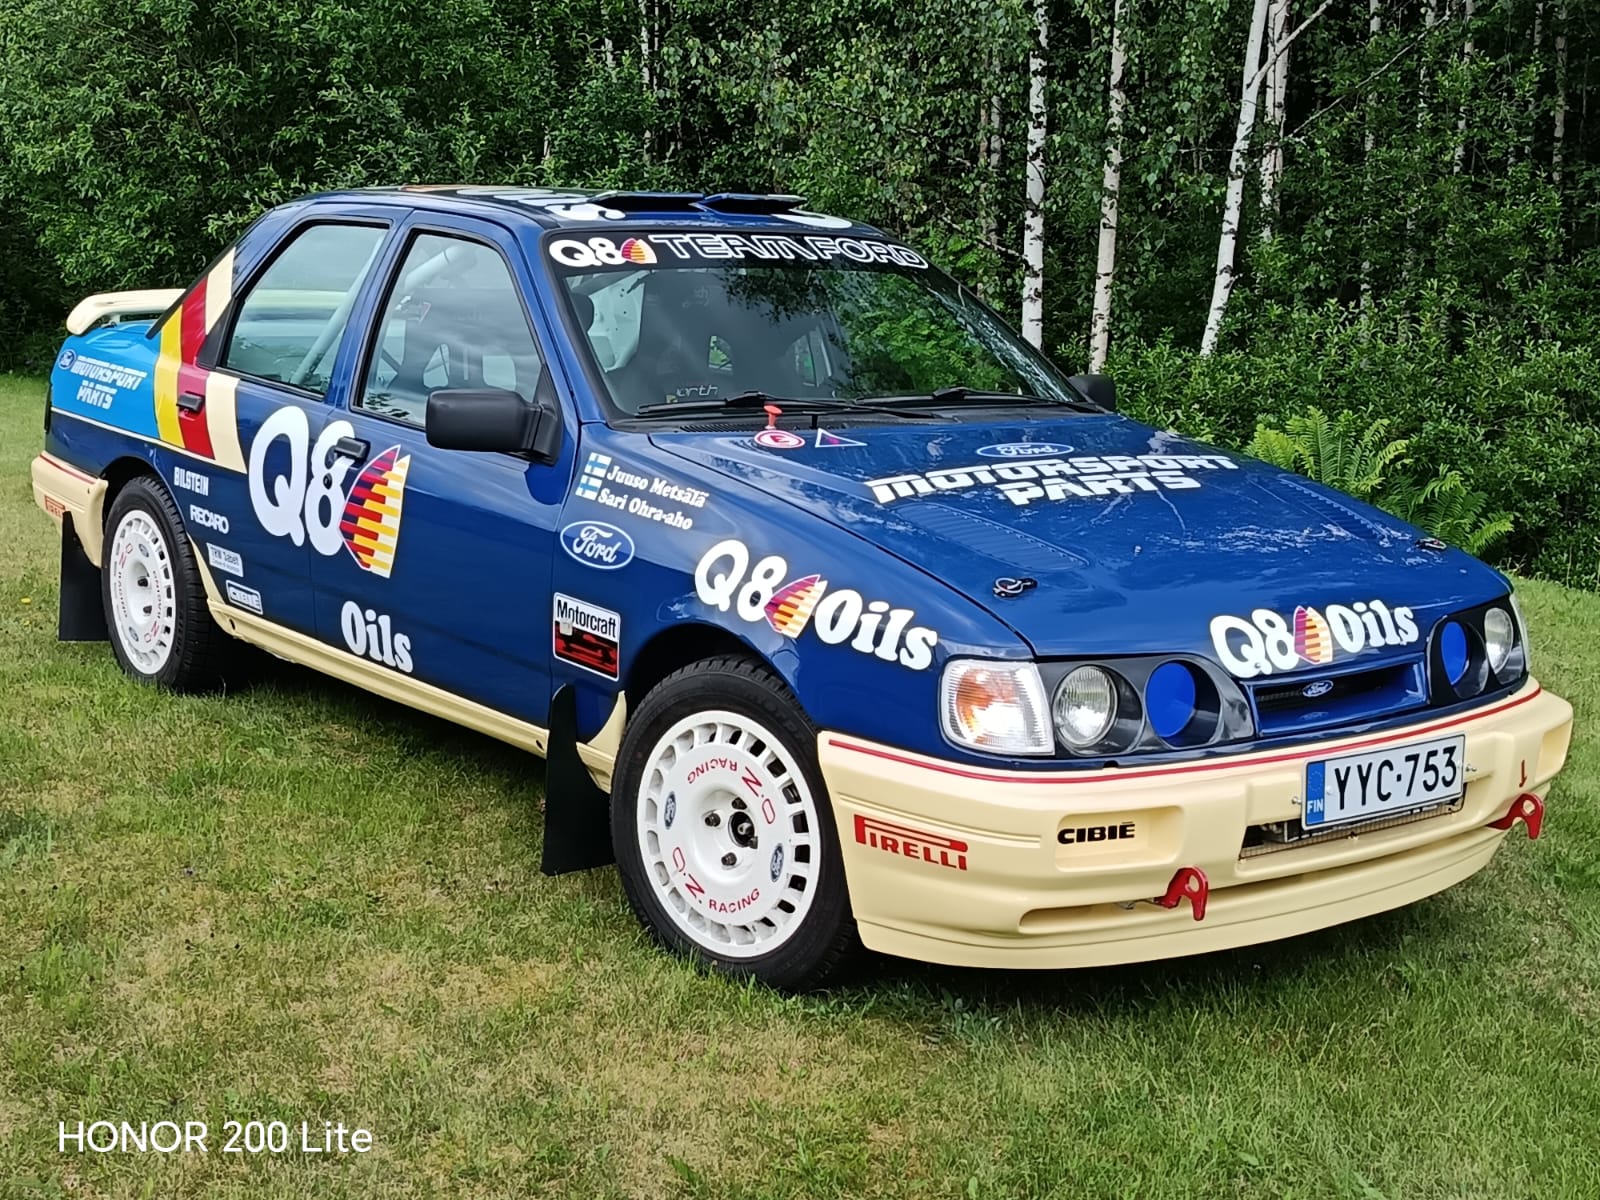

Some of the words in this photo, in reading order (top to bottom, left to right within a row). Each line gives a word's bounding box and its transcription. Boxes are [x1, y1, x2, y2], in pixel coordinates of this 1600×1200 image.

[549, 237, 627, 267] Q8
[648, 234, 818, 260] TEAM
[804, 236, 929, 269] FORD
[174, 466, 209, 496] BILSTEIN
[249, 405, 356, 556] Q8
[607, 466, 648, 490] Juuso
[649, 478, 710, 508] Metsälä
[865, 455, 1240, 504] MOTORSPORT
[995, 470, 1202, 506] PARTS
[190, 504, 230, 534] RECARO
[598, 488, 629, 510] Sari
[628, 497, 693, 530] Ohra-aho
[557, 600, 617, 638] Motorcraft
[694, 539, 788, 622] Q8
[813, 589, 938, 671] Oils
[341, 600, 414, 673] Oils
[1209, 608, 1302, 679] Q8
[1325, 599, 1419, 653] Oils
[687, 758, 738, 784] RACING
[1307, 798, 1324, 814] FIN
[853, 814, 968, 871] PIRELLI
[708, 888, 760, 913] RACING
